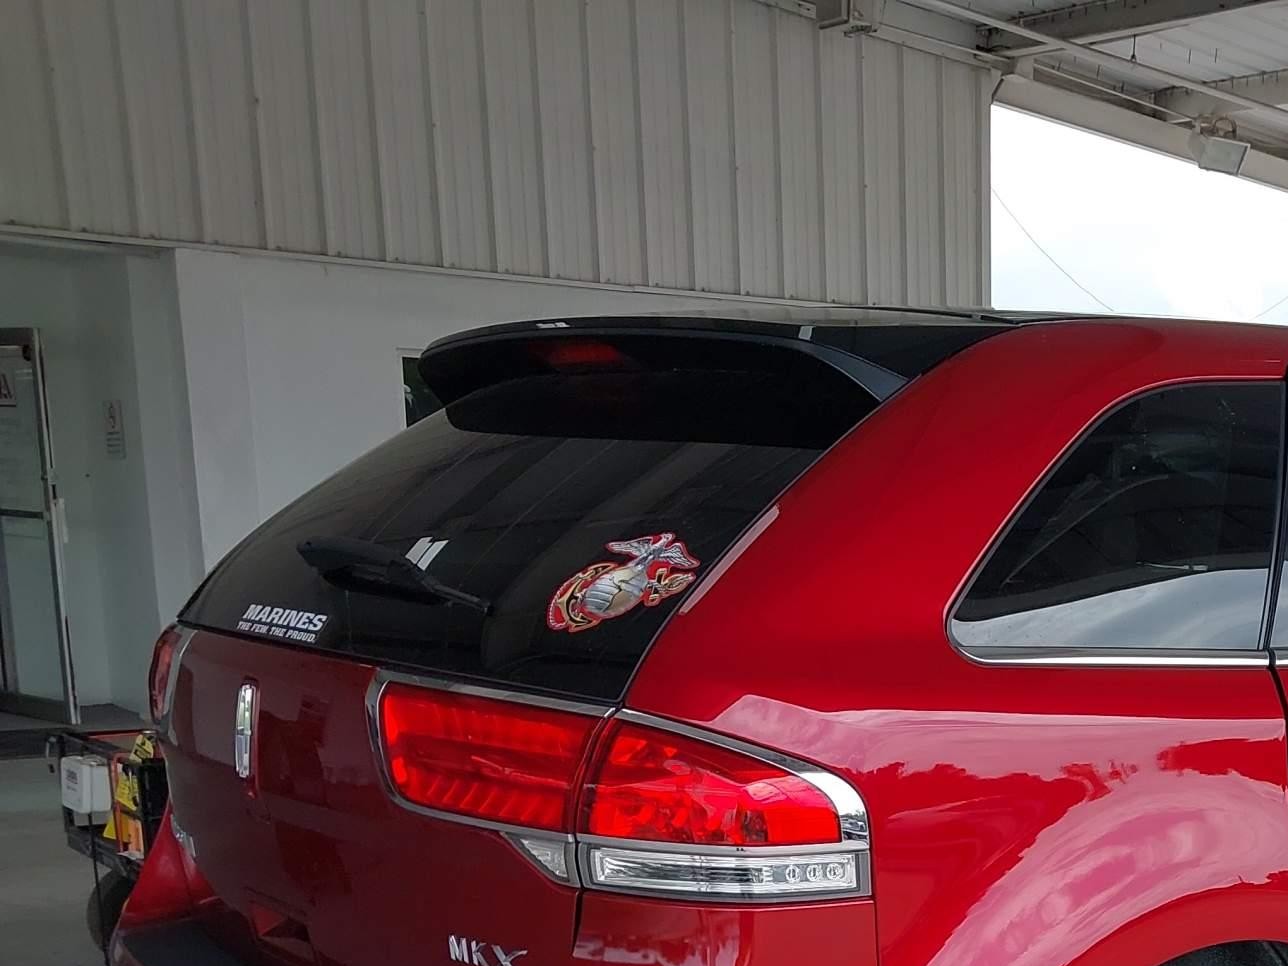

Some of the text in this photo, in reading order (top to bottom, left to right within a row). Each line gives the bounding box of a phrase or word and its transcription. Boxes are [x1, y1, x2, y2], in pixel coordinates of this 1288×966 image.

[242, 604, 328, 631] MARINES
[237, 621, 252, 631] THE
[269, 626, 286, 637] THE
